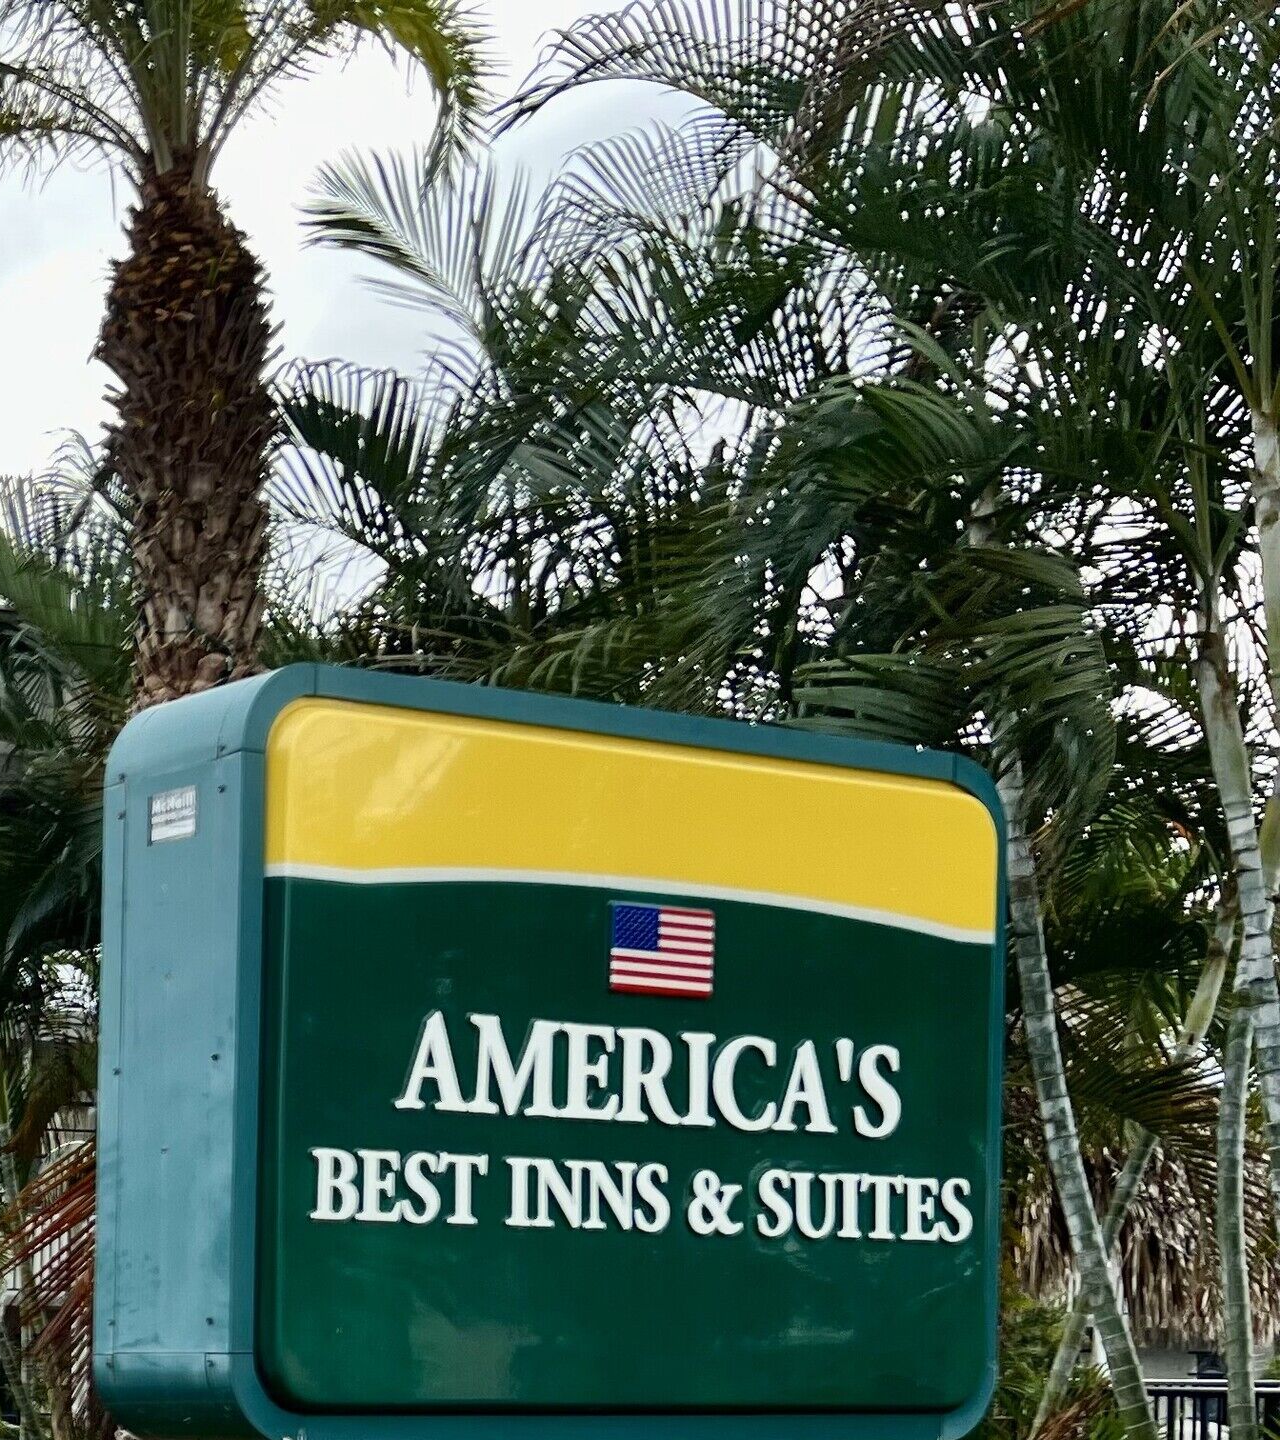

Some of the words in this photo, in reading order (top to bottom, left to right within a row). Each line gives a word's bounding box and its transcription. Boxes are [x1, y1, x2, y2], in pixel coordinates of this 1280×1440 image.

[393, 1010, 903, 1139] AMERICA'S
[309, 1146, 490, 1226] BEST
[504, 1156, 672, 1234] INNS
[686, 1168, 745, 1236] &
[756, 1168, 974, 1244] SUITES
